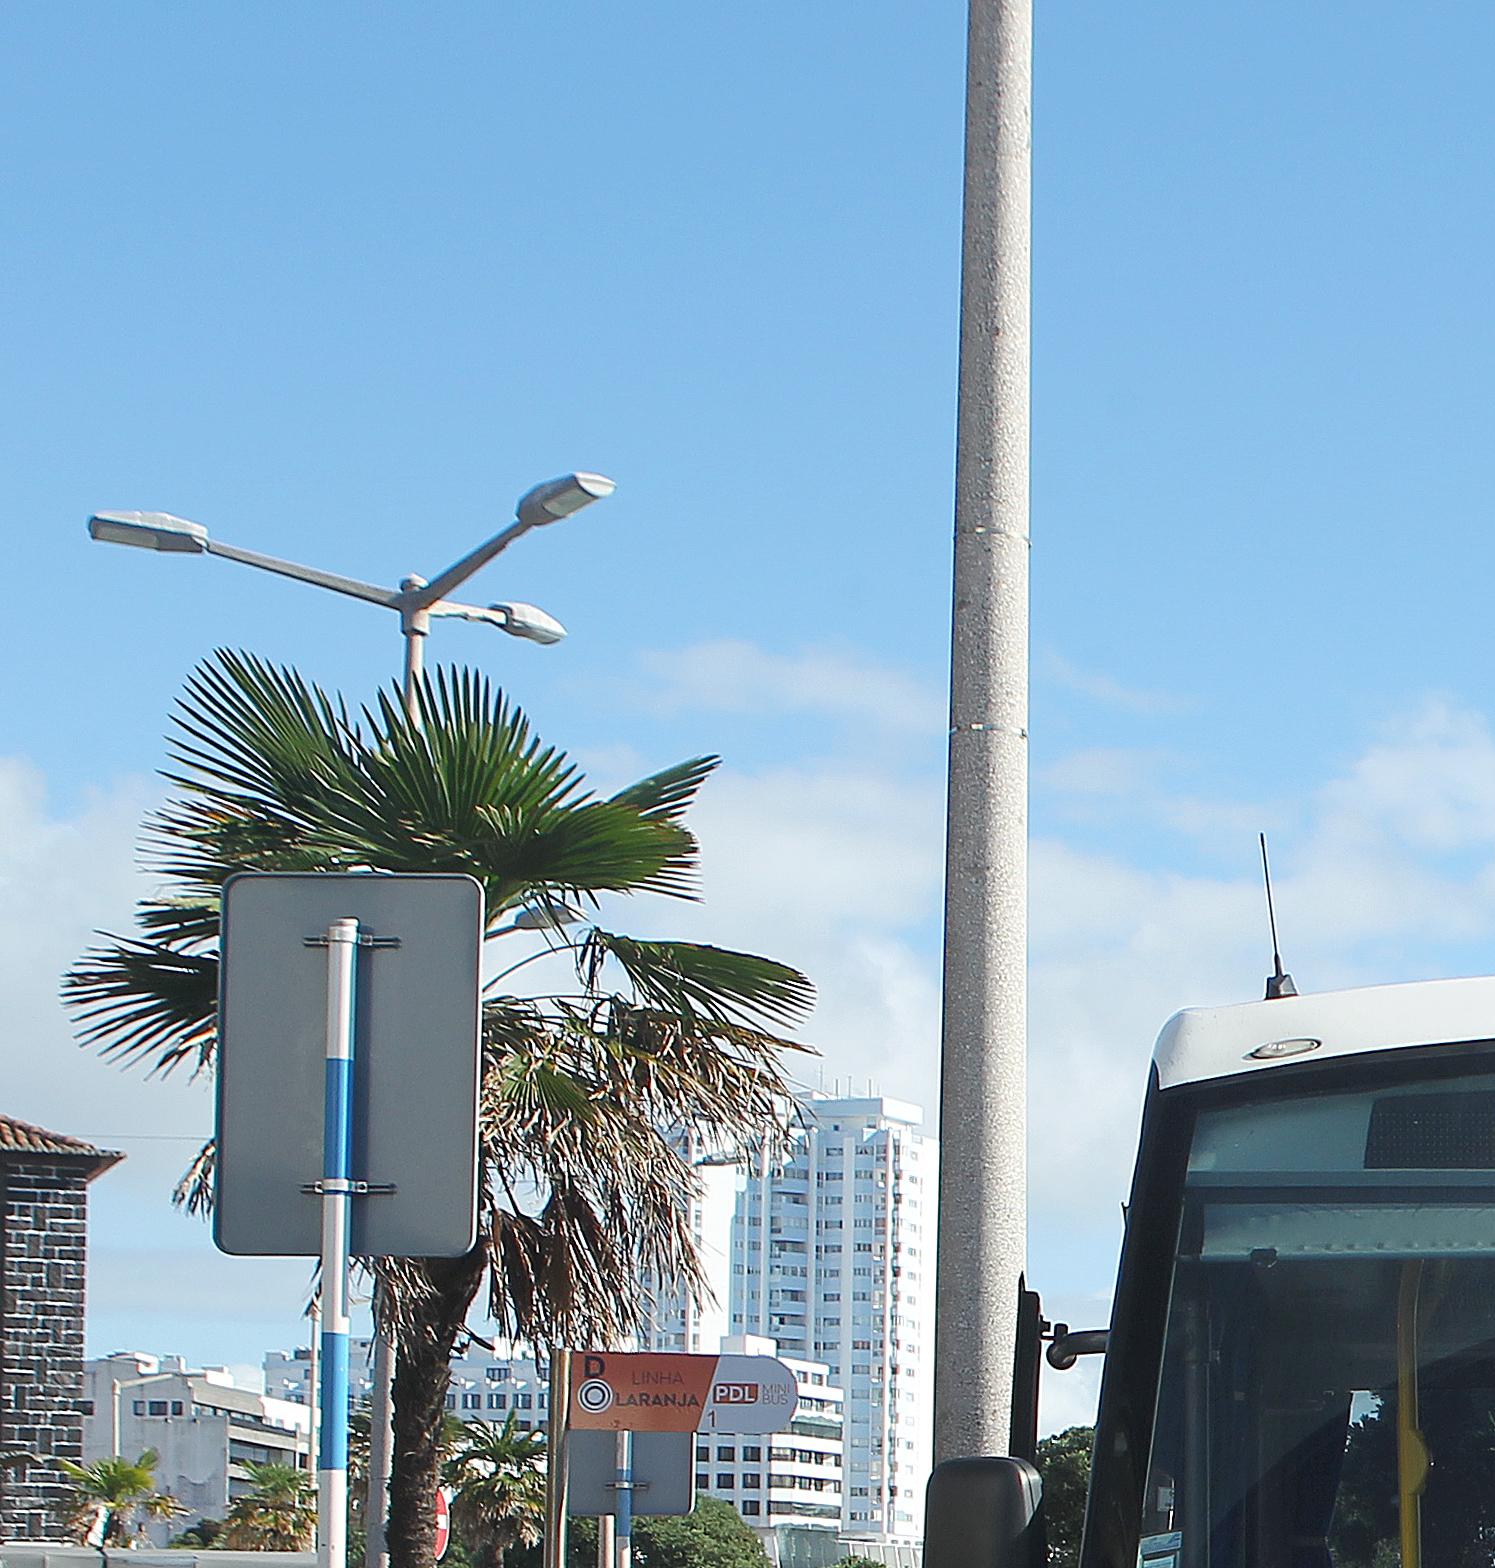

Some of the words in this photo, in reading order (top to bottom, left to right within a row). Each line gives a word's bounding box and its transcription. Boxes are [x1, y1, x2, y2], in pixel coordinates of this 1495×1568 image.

[583, 1356, 605, 1377] D
[632, 1371, 684, 1386] LINHA
[715, 1385, 756, 1402] PDL
[762, 1384, 790, 1395] MINI
[615, 1392, 700, 1408] LARANJA
[762, 1394, 789, 1406] BUS
[707, 1410, 717, 1428] 1
